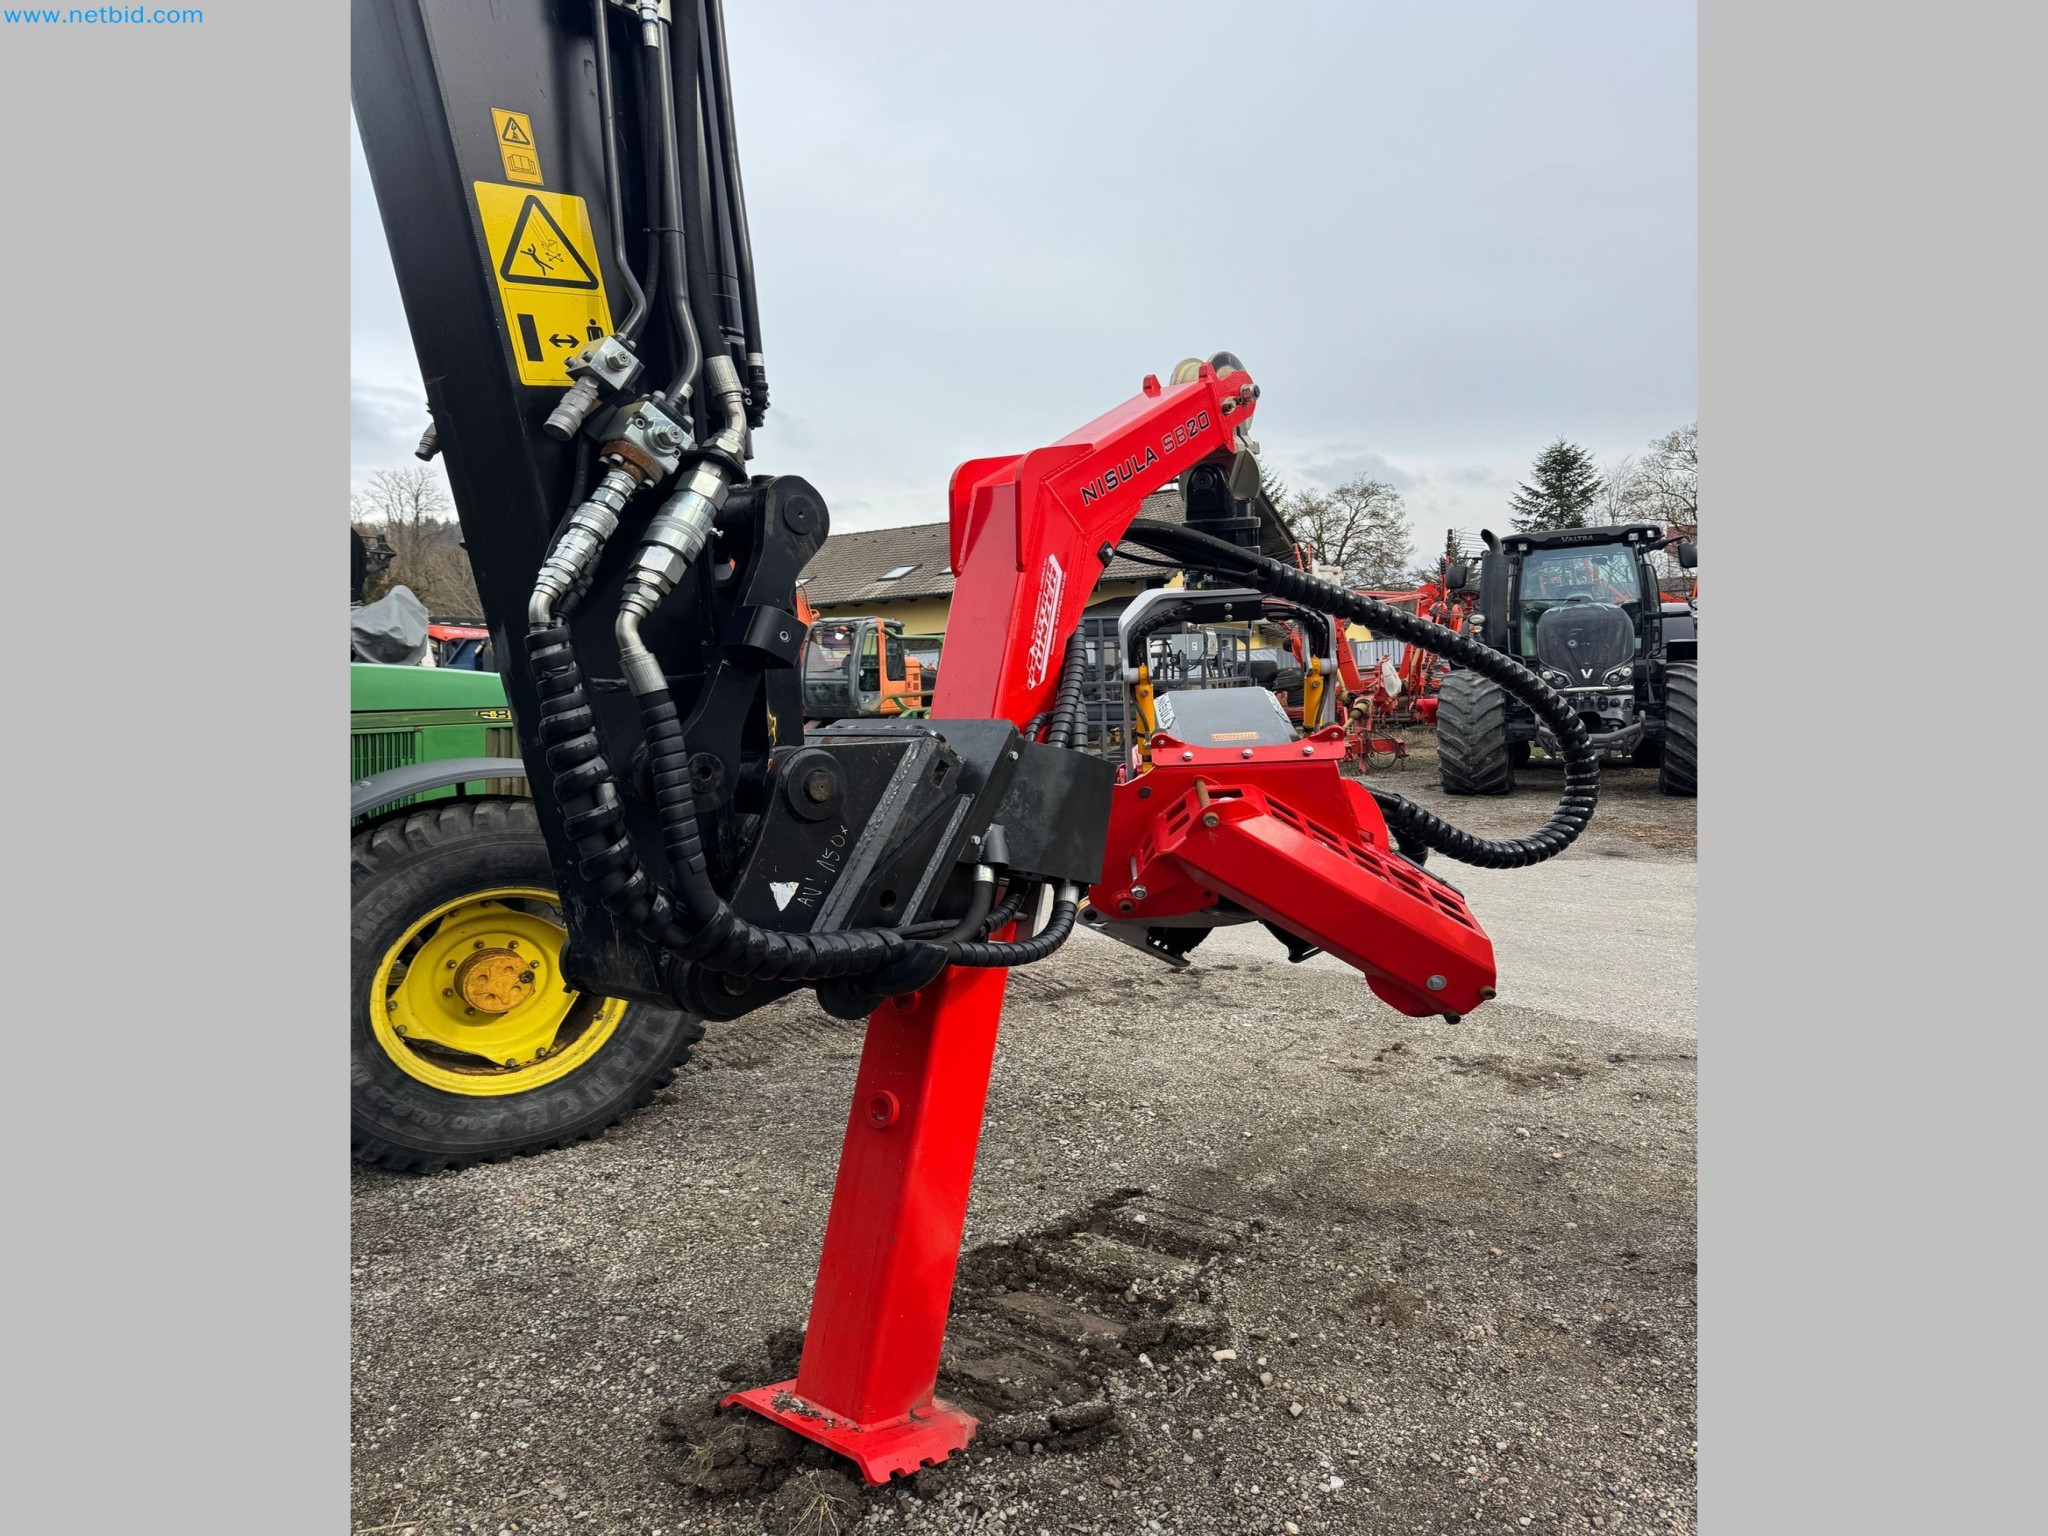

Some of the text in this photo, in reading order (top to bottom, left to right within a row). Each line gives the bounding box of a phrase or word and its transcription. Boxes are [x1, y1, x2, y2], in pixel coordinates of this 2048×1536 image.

[1081, 411, 1210, 506] NISULA SB20
[1561, 534, 1594, 543] VALTRA
